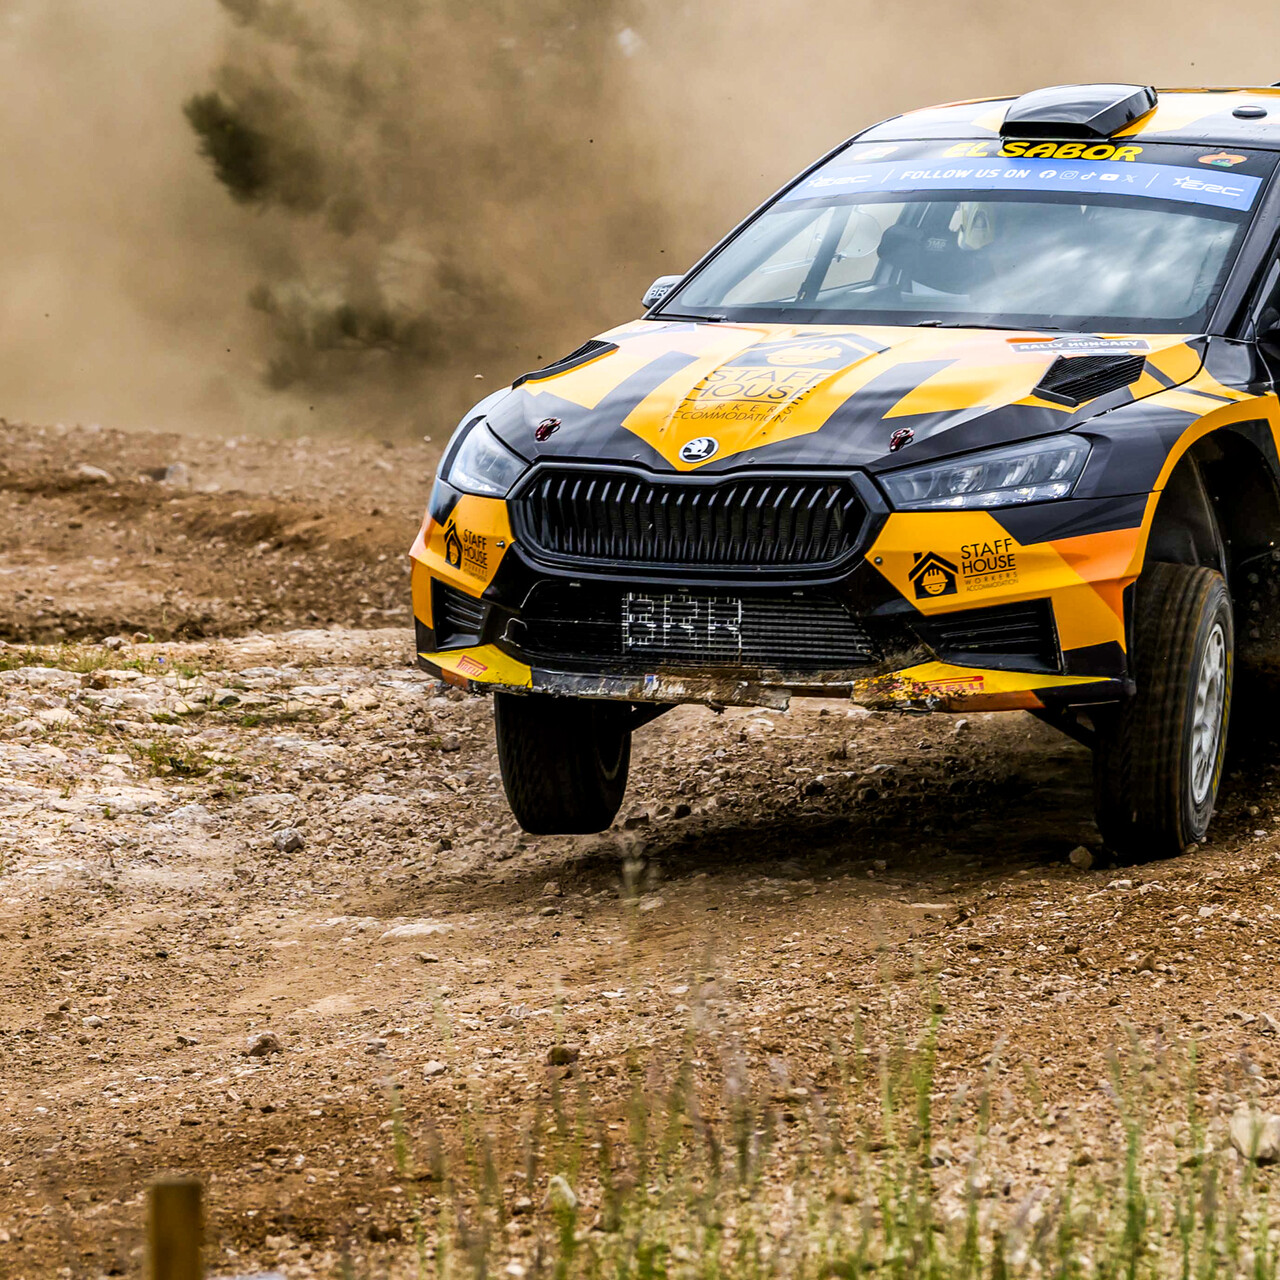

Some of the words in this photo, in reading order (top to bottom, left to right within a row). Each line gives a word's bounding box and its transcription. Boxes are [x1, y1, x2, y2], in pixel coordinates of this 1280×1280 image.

[942, 142, 989, 157] EL
[997, 142, 1143, 161] SABOR
[900, 169, 972, 180] FOLLOW
[975, 169, 1001, 179] US
[1006, 169, 1031, 179] ON
[649, 287, 670, 298] BR
[1020, 342, 1062, 350] RALLY
[1068, 340, 1138, 348] HUNGARY
[705, 370, 829, 382] STAFF
[693, 383, 816, 400] HOUSE
[662, 411, 788, 423] ACCOMMODATION
[463, 529, 487, 550] STAFF
[463, 544, 487, 566] HOUSE
[960, 538, 1013, 559] STAFF
[962, 554, 1016, 574] HOUSE
[964, 572, 1018, 585] WORKERS
